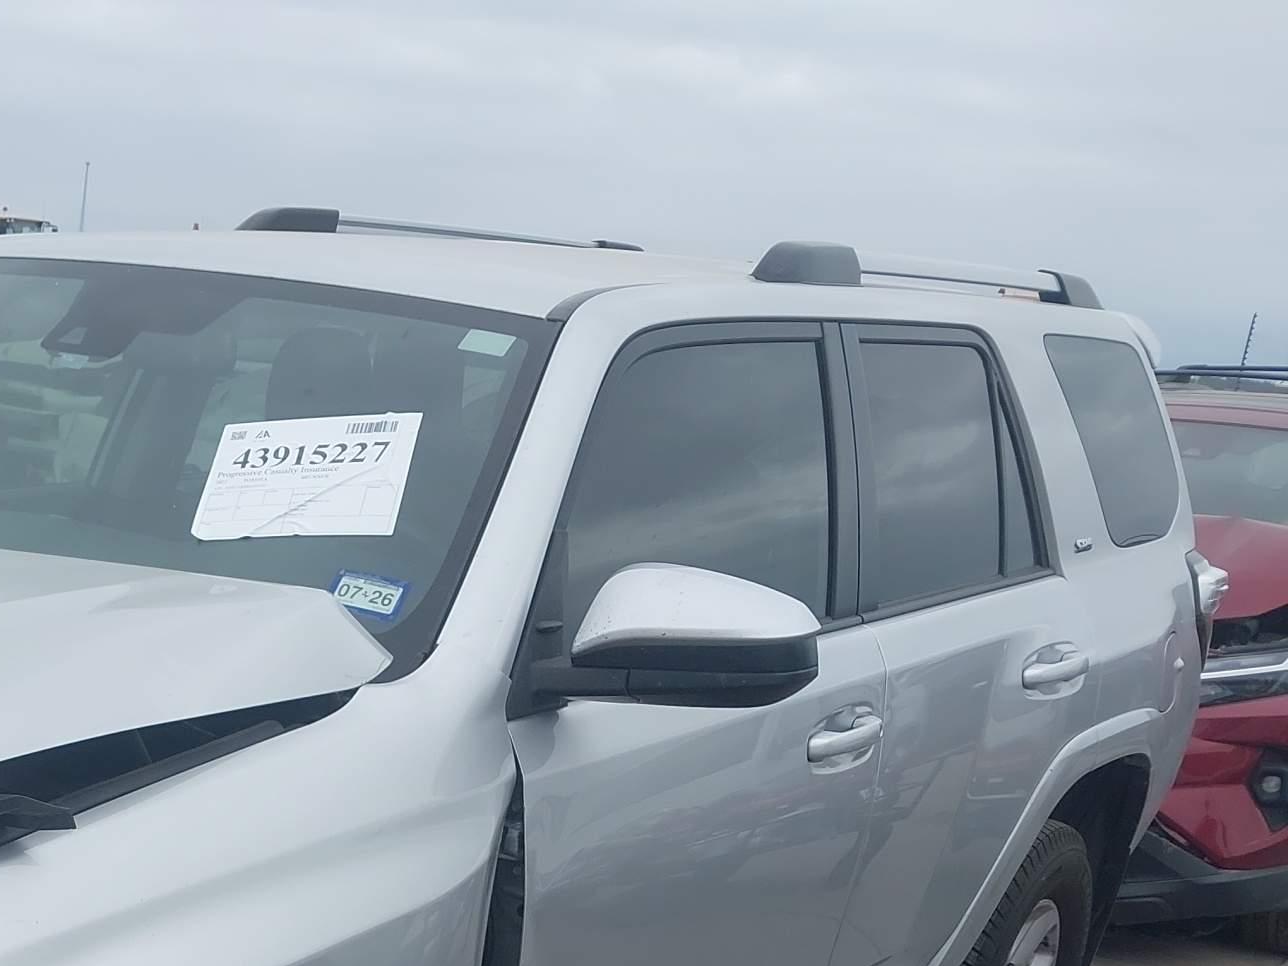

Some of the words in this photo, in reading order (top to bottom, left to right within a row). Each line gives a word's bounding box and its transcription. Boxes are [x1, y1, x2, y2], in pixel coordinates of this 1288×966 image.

[233, 441, 390, 468] 43915227
[217, 469, 262, 479] Progressive
[264, 466, 298, 475] Casualty
[300, 464, 339, 473] Insurance
